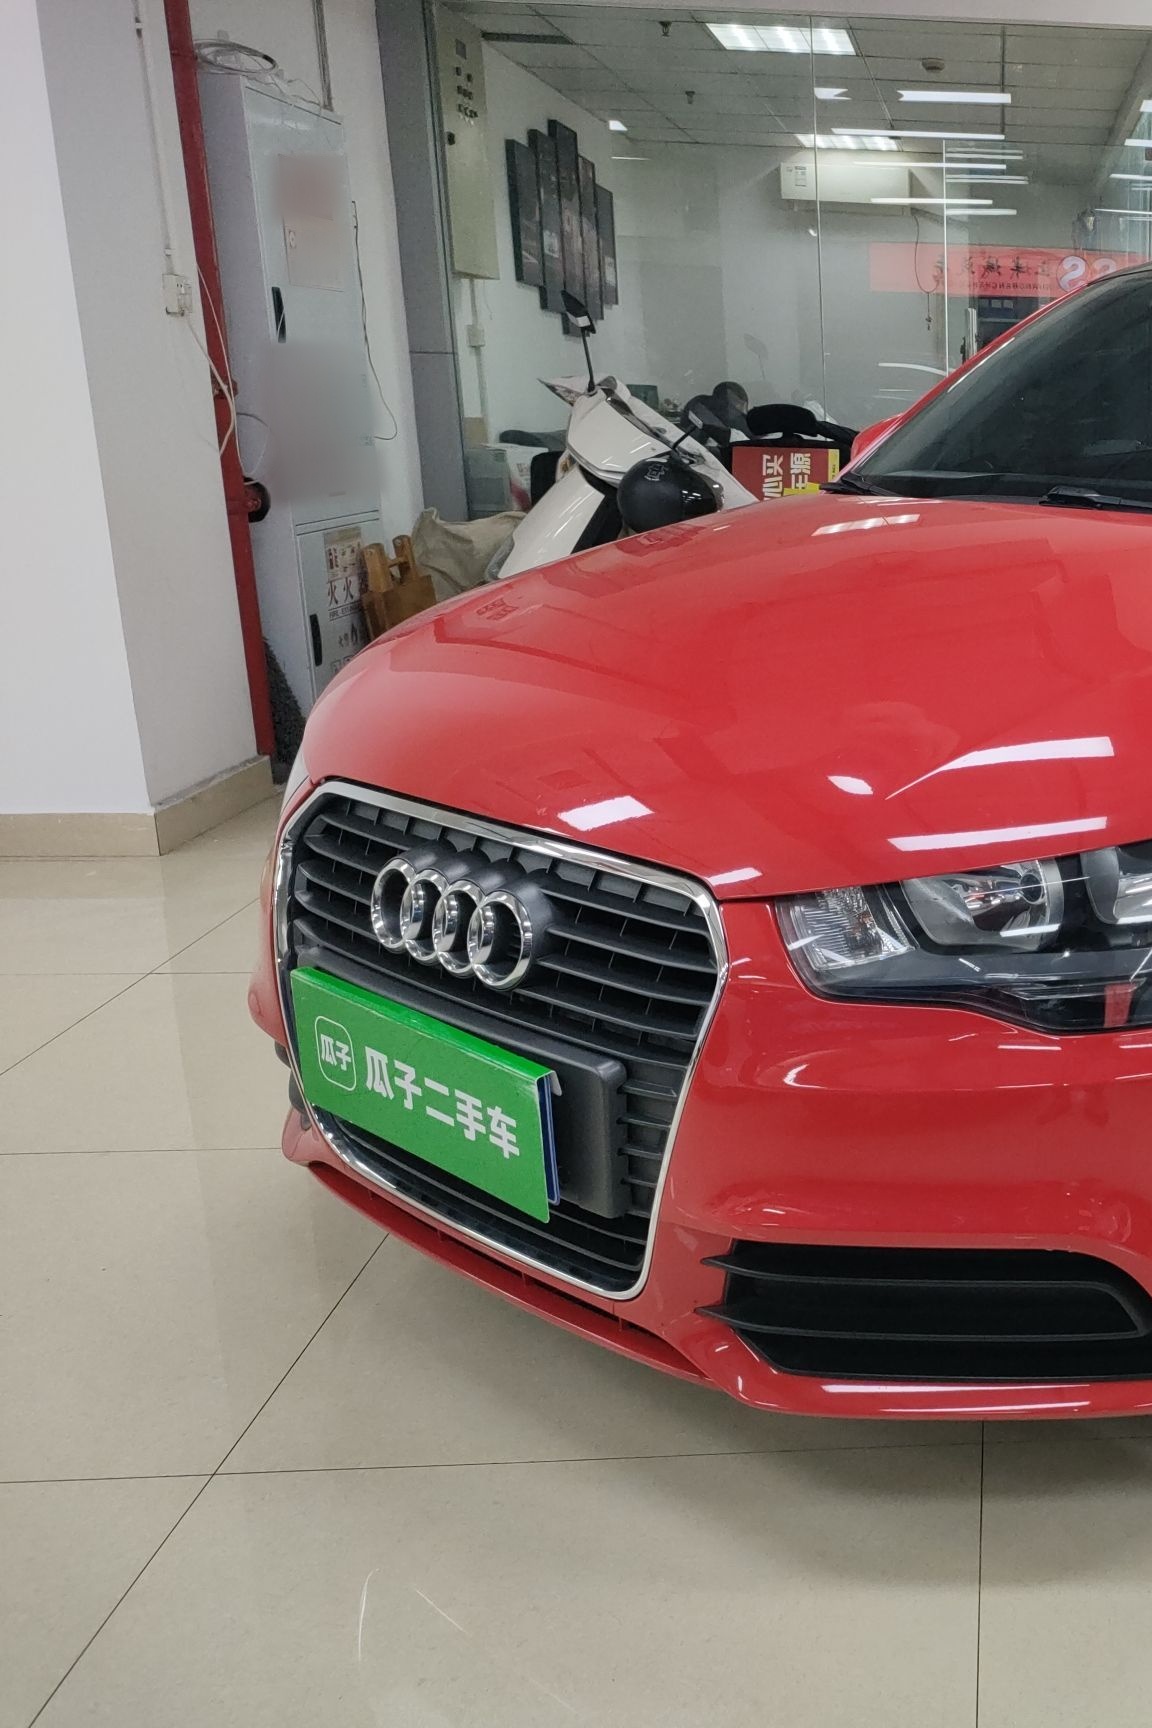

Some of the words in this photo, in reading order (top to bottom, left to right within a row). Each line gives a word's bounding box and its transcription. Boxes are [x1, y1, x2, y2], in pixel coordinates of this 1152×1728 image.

[762, 454, 784, 500] 心买
[320, 1033, 352, 1071] 瓜子
[364, 1046, 520, 1159] 瓜子二手车
